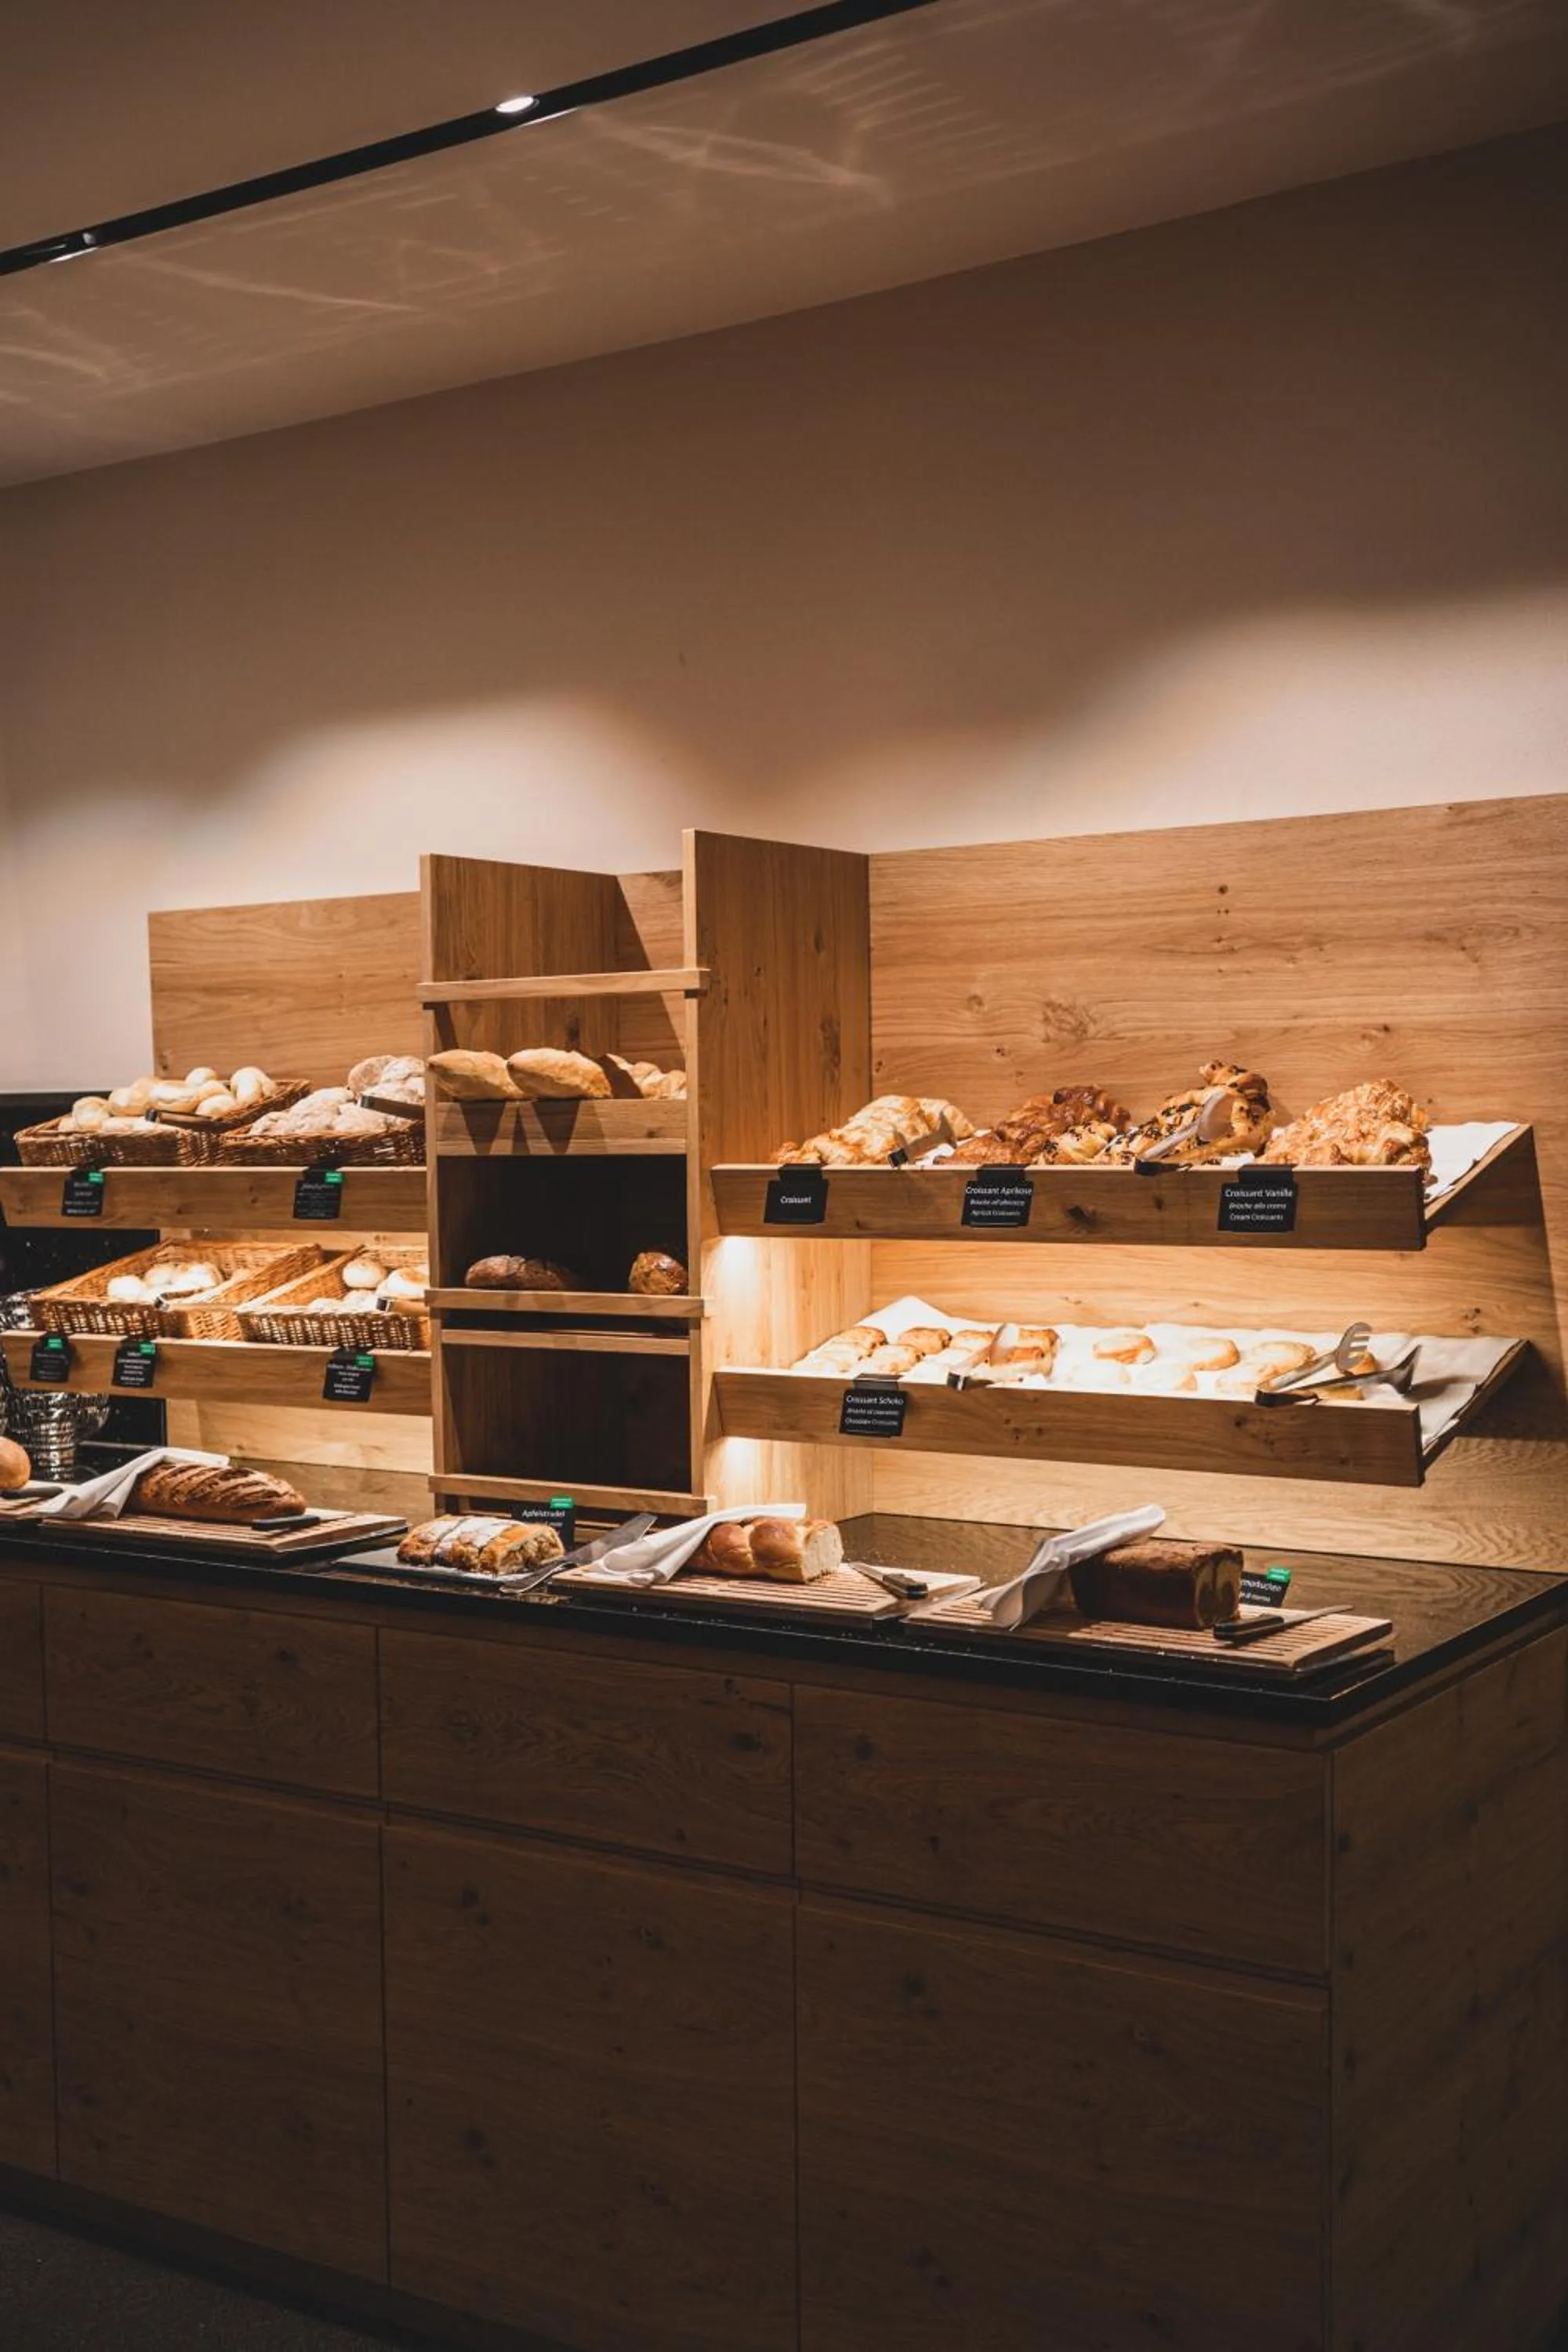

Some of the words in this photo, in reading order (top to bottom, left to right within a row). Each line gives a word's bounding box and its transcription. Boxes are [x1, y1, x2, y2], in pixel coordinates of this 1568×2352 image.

[1000, 1186, 1032, 1196] Aprikose
[1225, 1189, 1262, 1197] Croissant
[1265, 1188, 1293, 1197] Vanille
[779, 1196, 811, 1204] Croissant
[847, 1395, 878, 1404] Croissant
[879, 1396, 904, 1406] Schoko
[521, 1510, 565, 1519] Apfelstrudel
